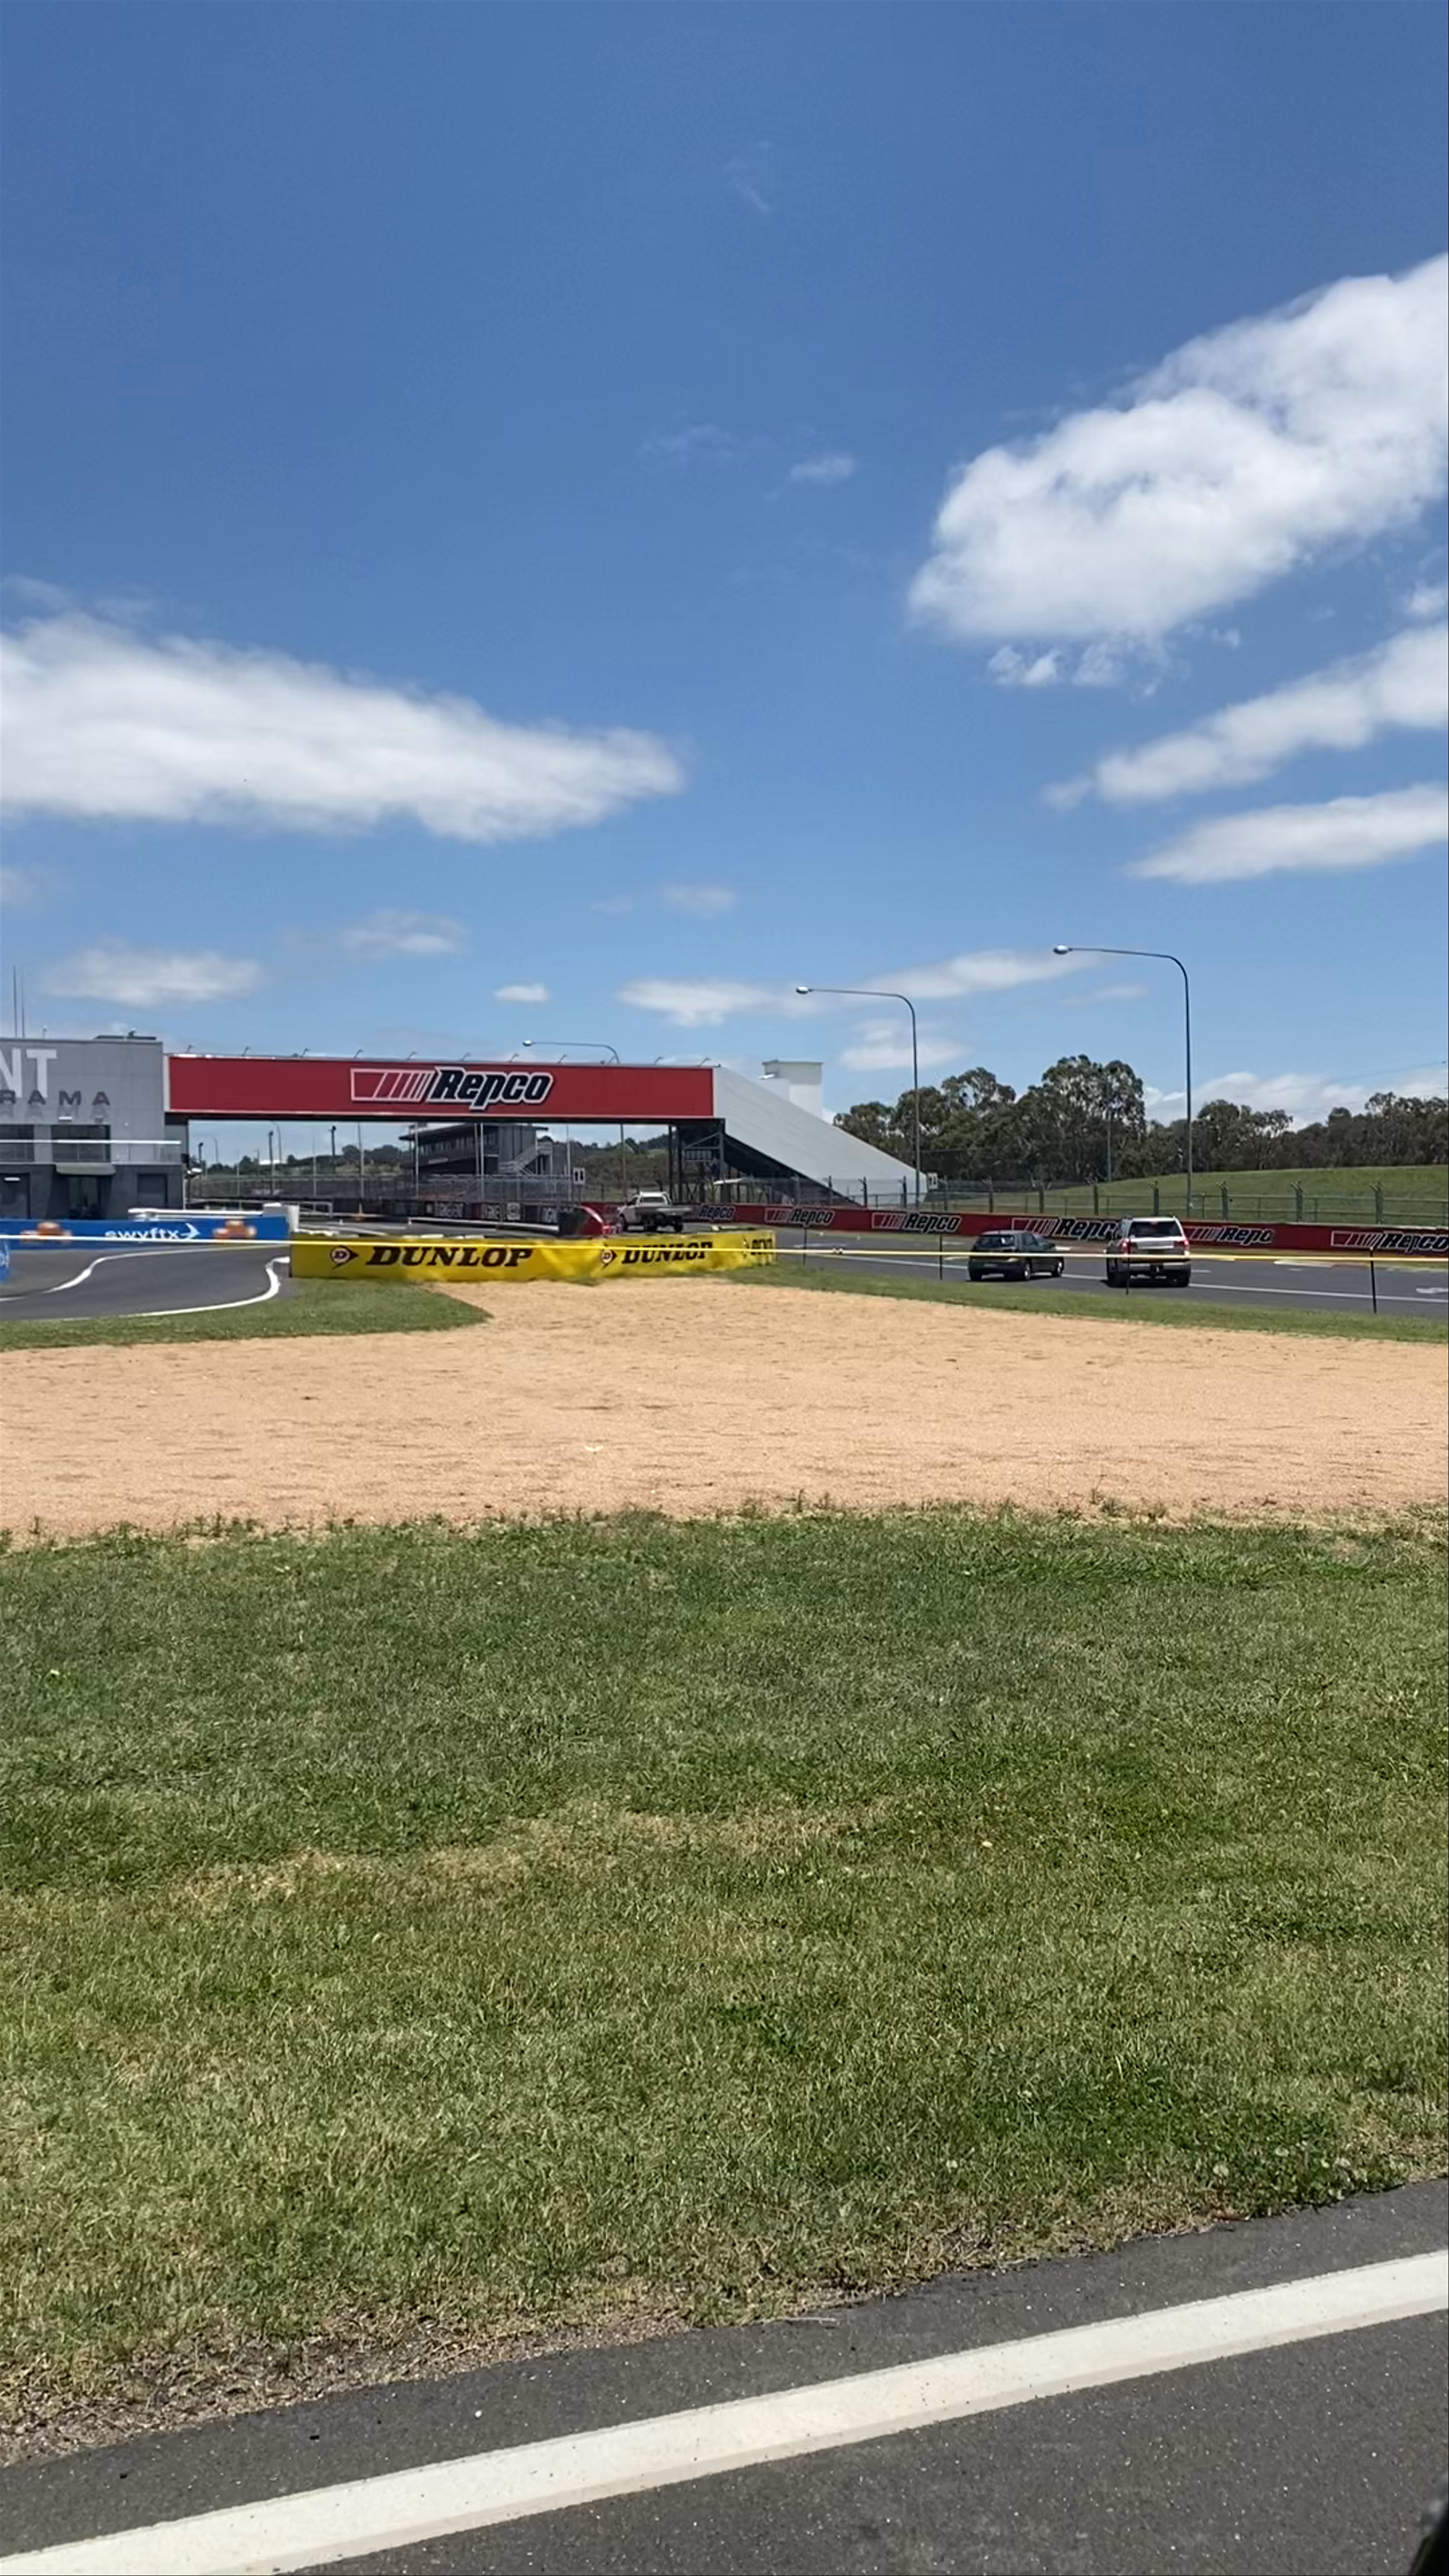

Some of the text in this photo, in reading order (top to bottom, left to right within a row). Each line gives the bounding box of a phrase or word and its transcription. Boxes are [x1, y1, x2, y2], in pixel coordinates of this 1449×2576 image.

[426, 1066, 553, 1109] Repco
[699, 1204, 735, 1221] Repco
[791, 1208, 835, 1227] Repco
[903, 1212, 961, 1233] Repco
[1053, 1217, 1118, 1241] Repc
[366, 1246, 533, 1267] DUNLOP
[622, 1242, 712, 1264] DUNLOP
